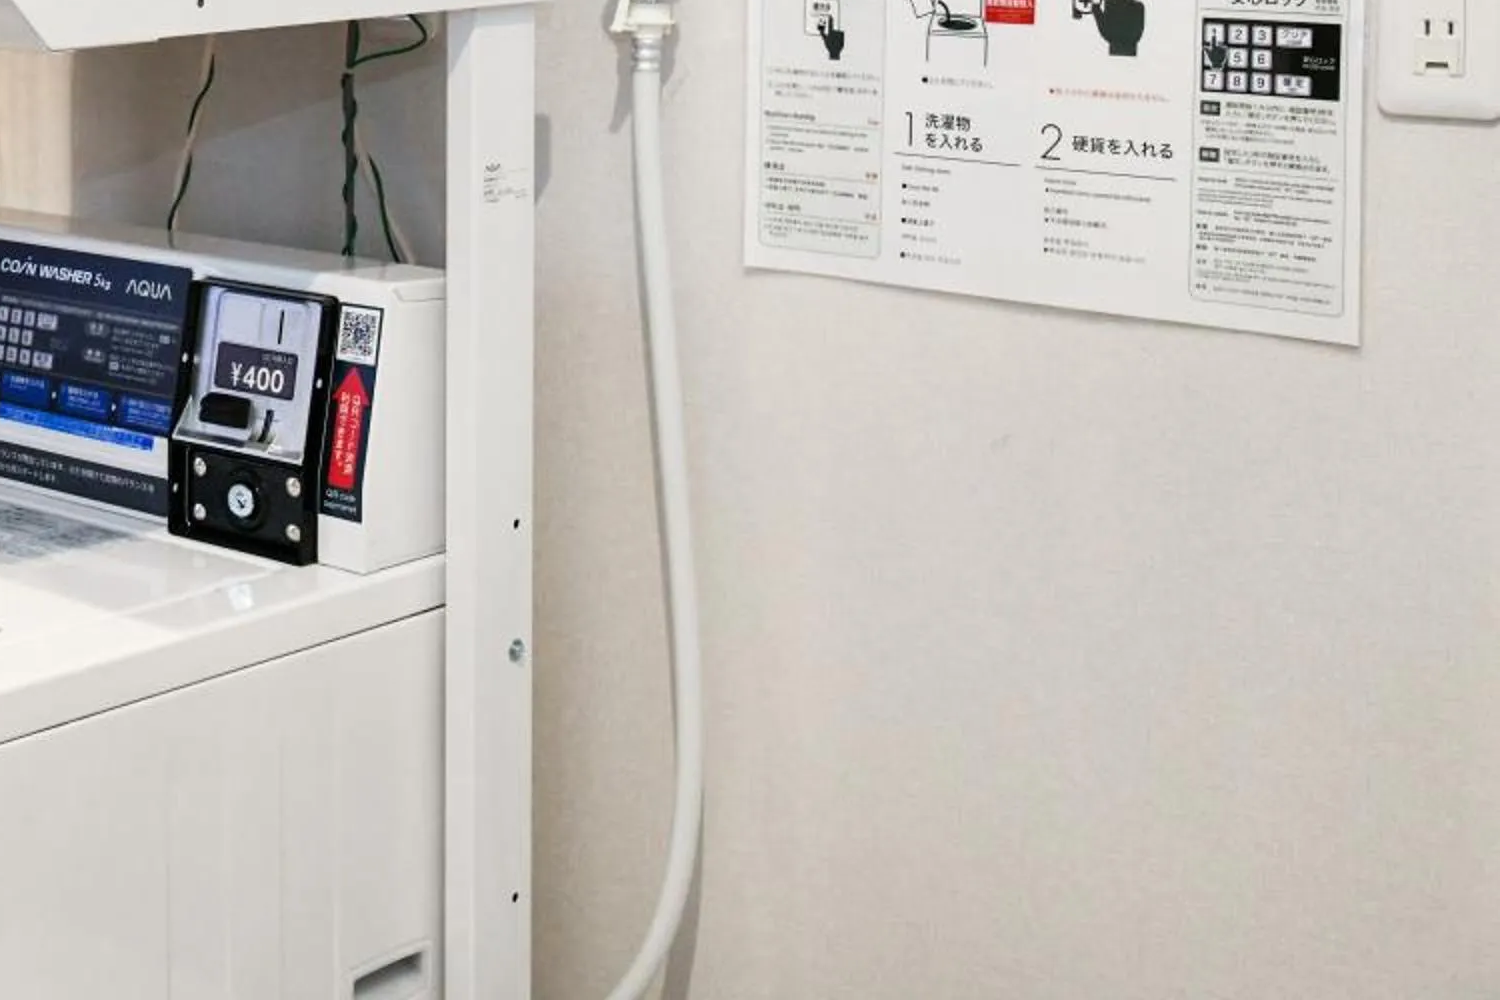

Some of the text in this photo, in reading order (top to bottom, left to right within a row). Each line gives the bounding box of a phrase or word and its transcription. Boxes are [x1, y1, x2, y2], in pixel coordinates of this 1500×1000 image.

[1235, 29, 1243, 40] 2
[1258, 30, 1266, 41] 3
[1209, 73, 1217, 85] 7
[906, 111, 971, 146] 1 洗濯物
[925, 133, 983, 152] を入れる
[1040, 123, 1173, 160] 2 硬貨を入れる
[39, 266, 93, 286] WASHER
[125, 279, 172, 300] AQUA
[231, 361, 284, 393] ¥400
